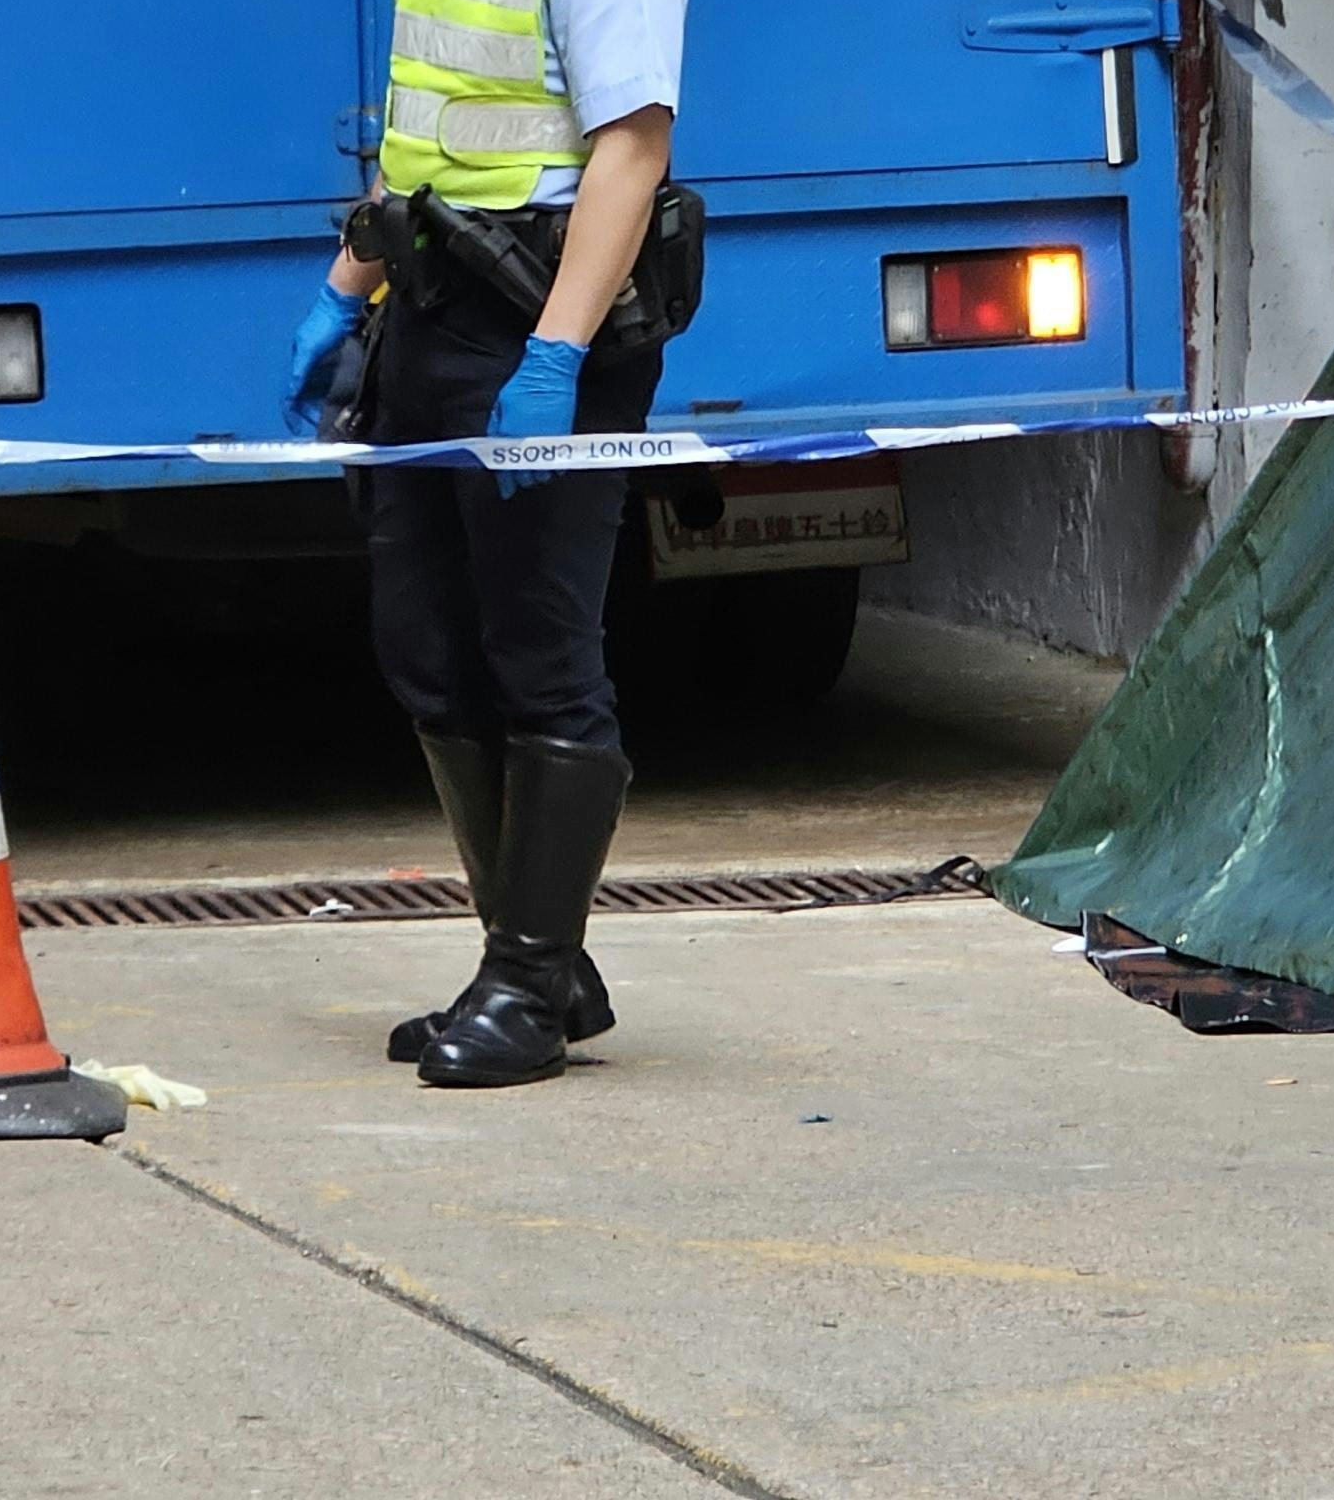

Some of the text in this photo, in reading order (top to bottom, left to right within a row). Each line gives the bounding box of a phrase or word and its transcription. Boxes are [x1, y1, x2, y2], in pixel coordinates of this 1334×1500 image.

[492, 439, 673, 464] DO NOT CROSS
